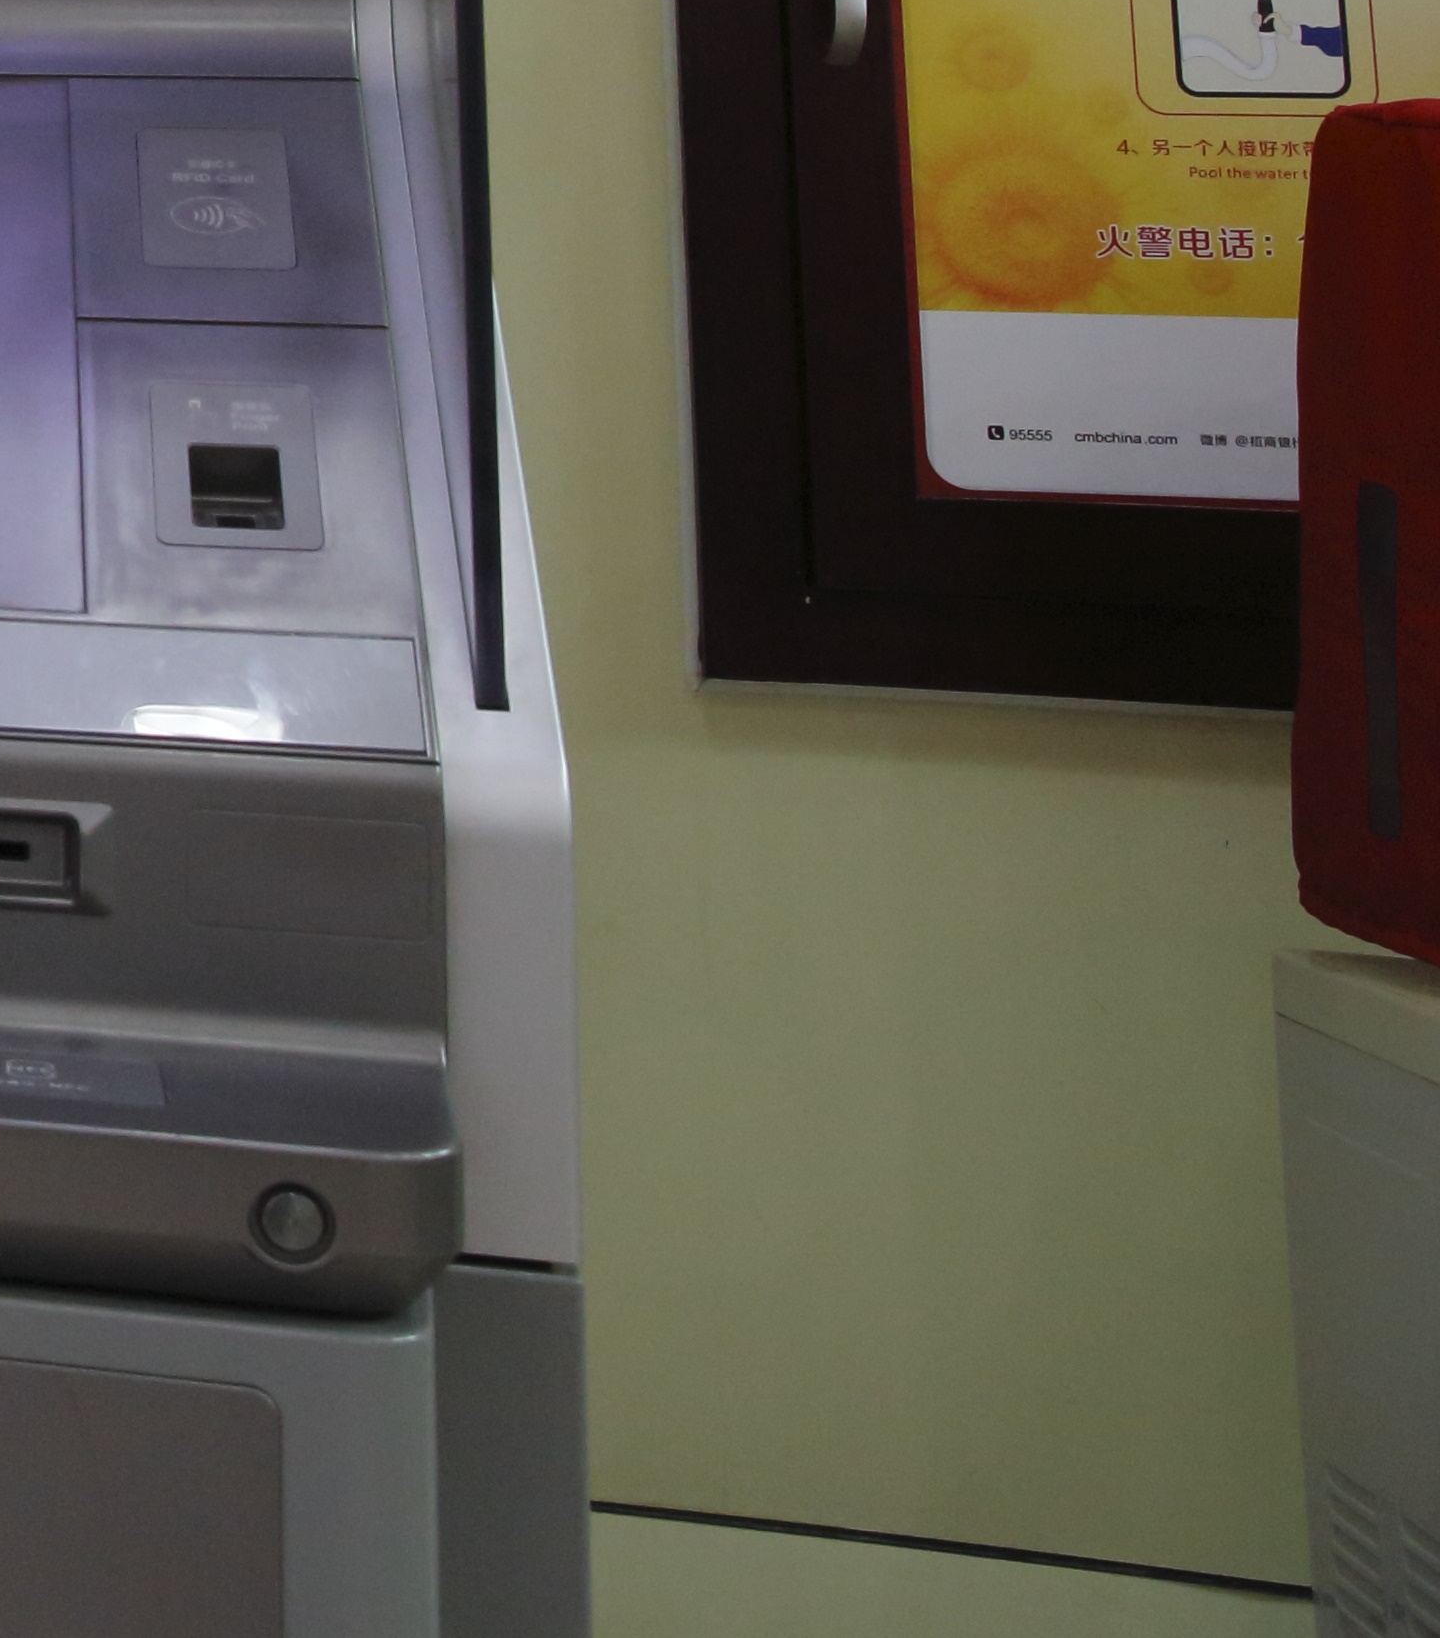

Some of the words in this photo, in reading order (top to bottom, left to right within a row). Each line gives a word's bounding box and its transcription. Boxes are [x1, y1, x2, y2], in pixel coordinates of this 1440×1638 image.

[1189, 166, 1223, 179] Pool
[1227, 167, 1251, 180] the
[1255, 169, 1298, 180] water
[1009, 428, 1053, 442] 95555
[1074, 431, 1178, 446] cmbchina.com
